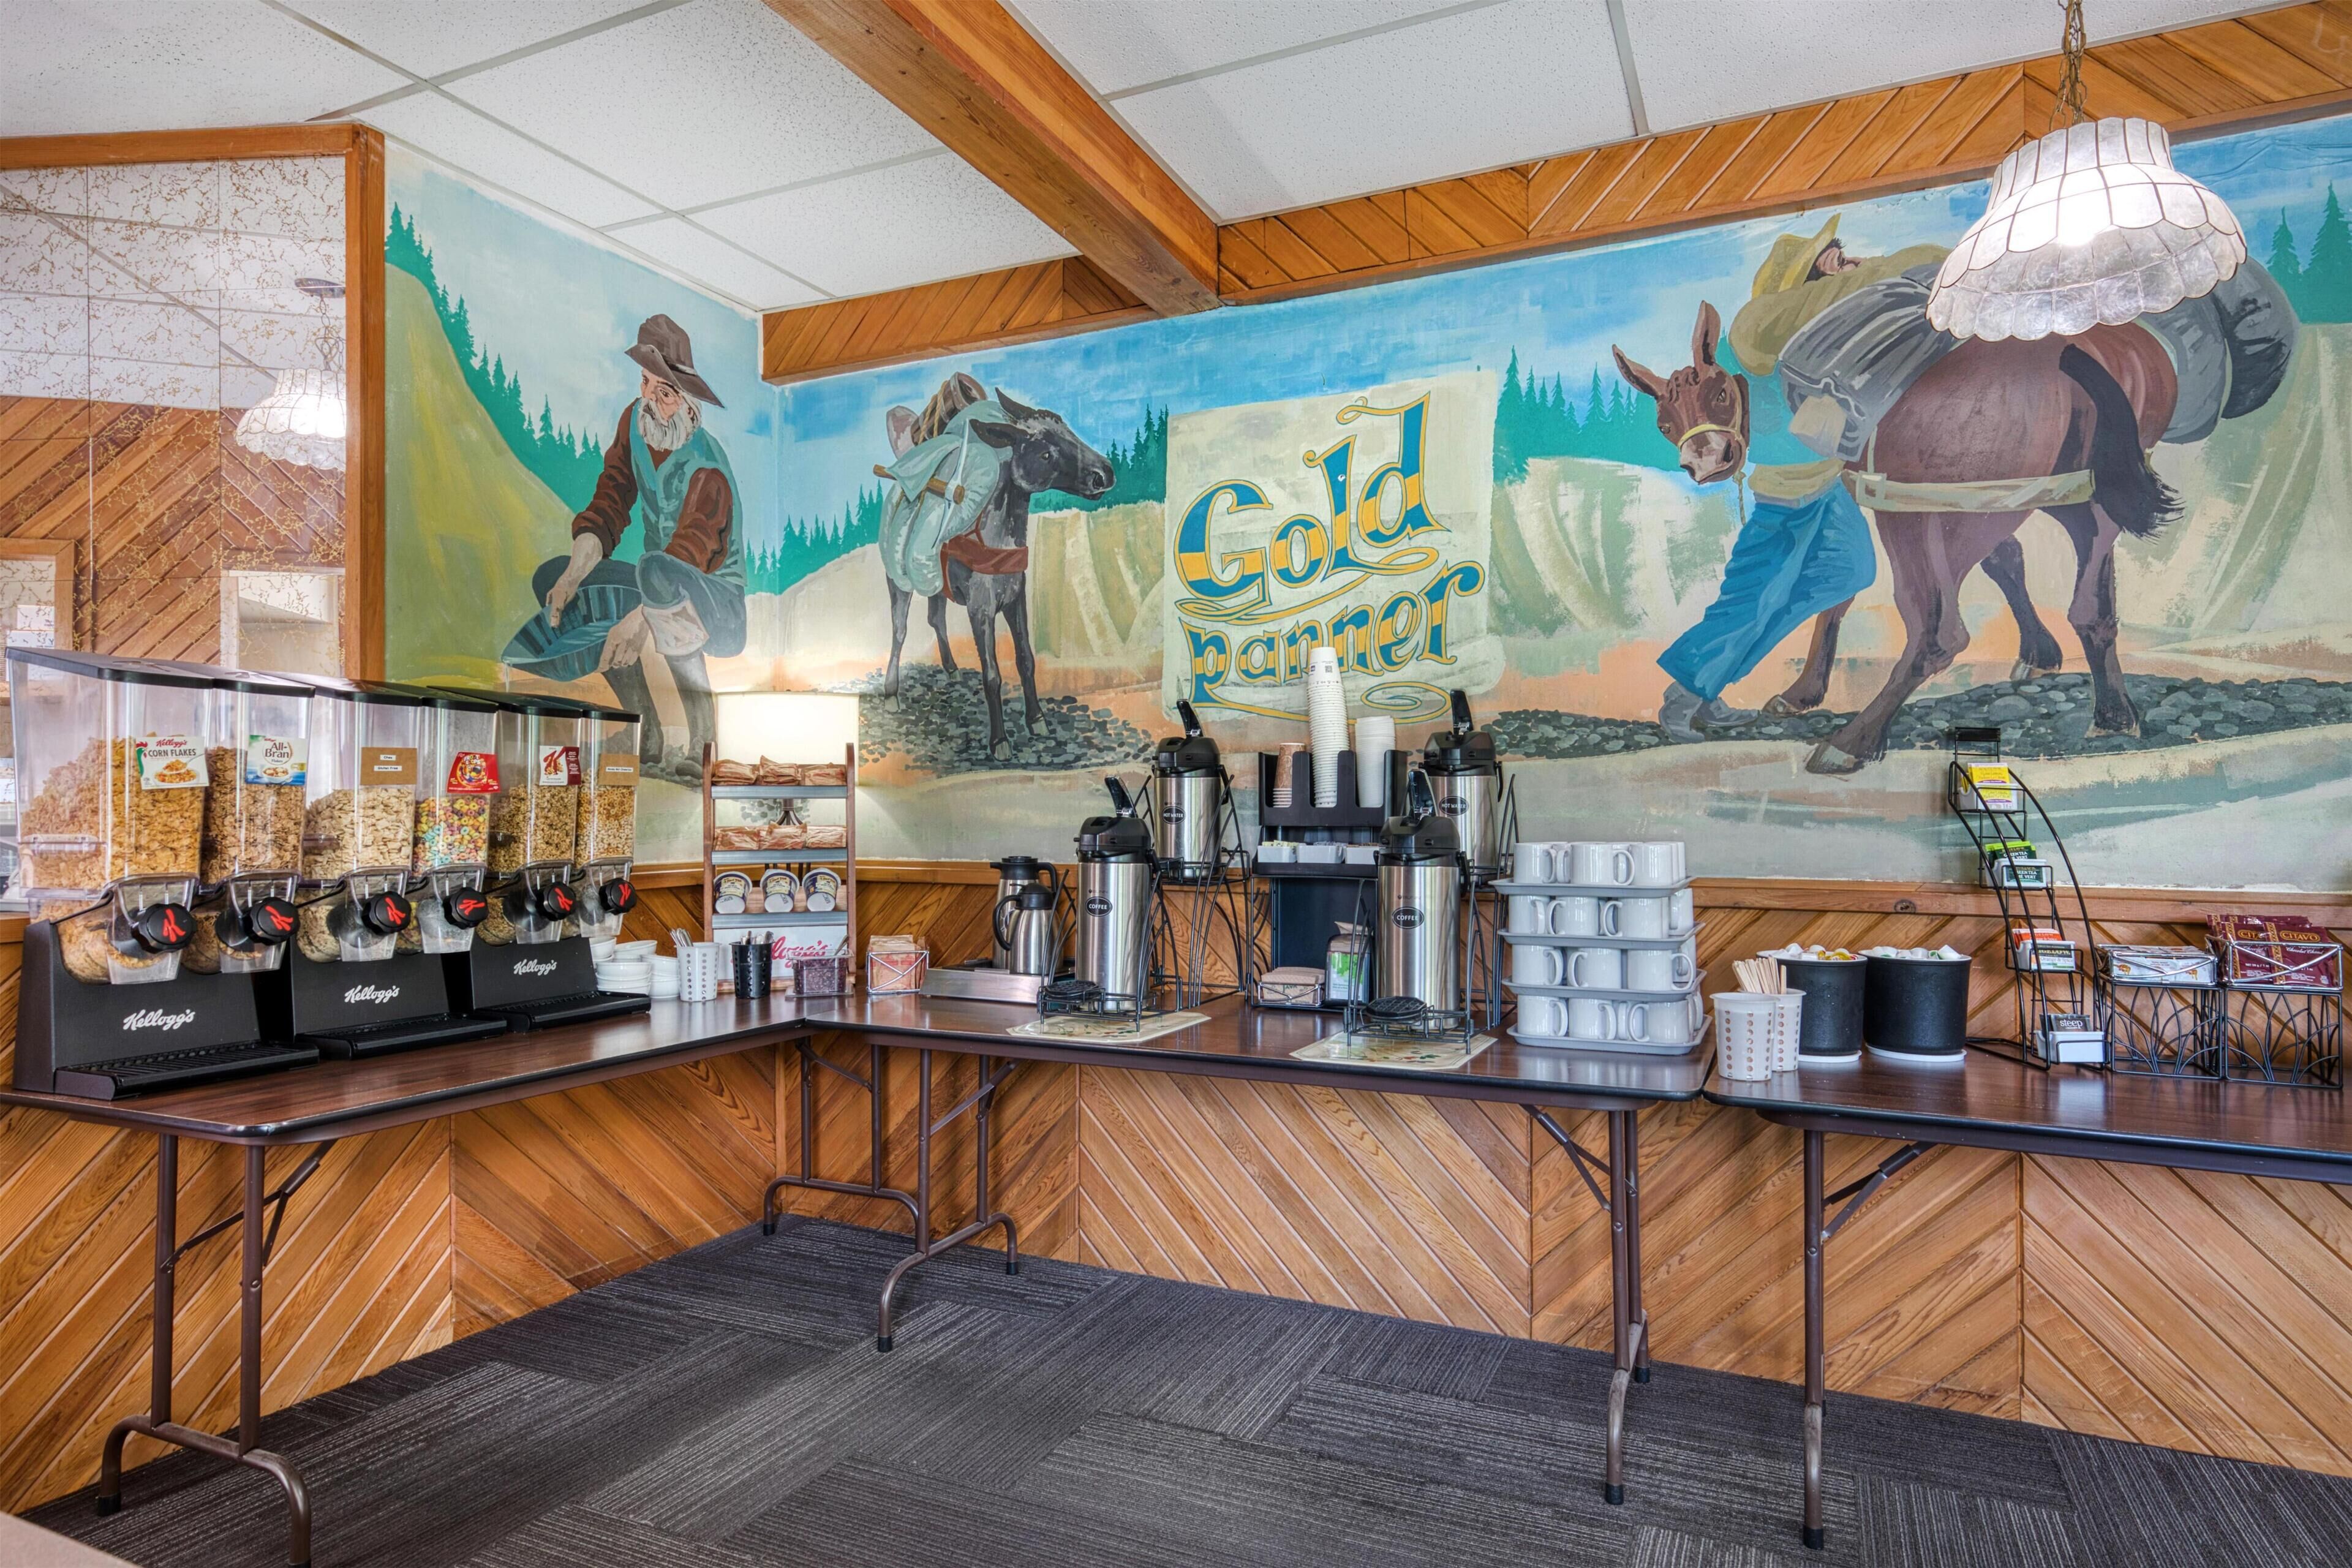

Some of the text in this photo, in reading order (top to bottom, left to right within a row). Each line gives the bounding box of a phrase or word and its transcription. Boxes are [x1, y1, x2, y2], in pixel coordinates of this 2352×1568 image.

[1174, 391, 1452, 605] Gold
[1178, 560, 1485, 707] panner
[156, 739, 187, 748] Kellogg's
[271, 742, 287, 751] All-
[265, 748, 289, 758] Bran
[2282, 932, 2318, 941] CITAVO
[513, 959, 557, 976] Kellogg's
[344, 985, 400, 1004] Kellogg's
[123, 1009, 195, 1031] Kellogg's
[2060, 1019, 2083, 1029] steep
